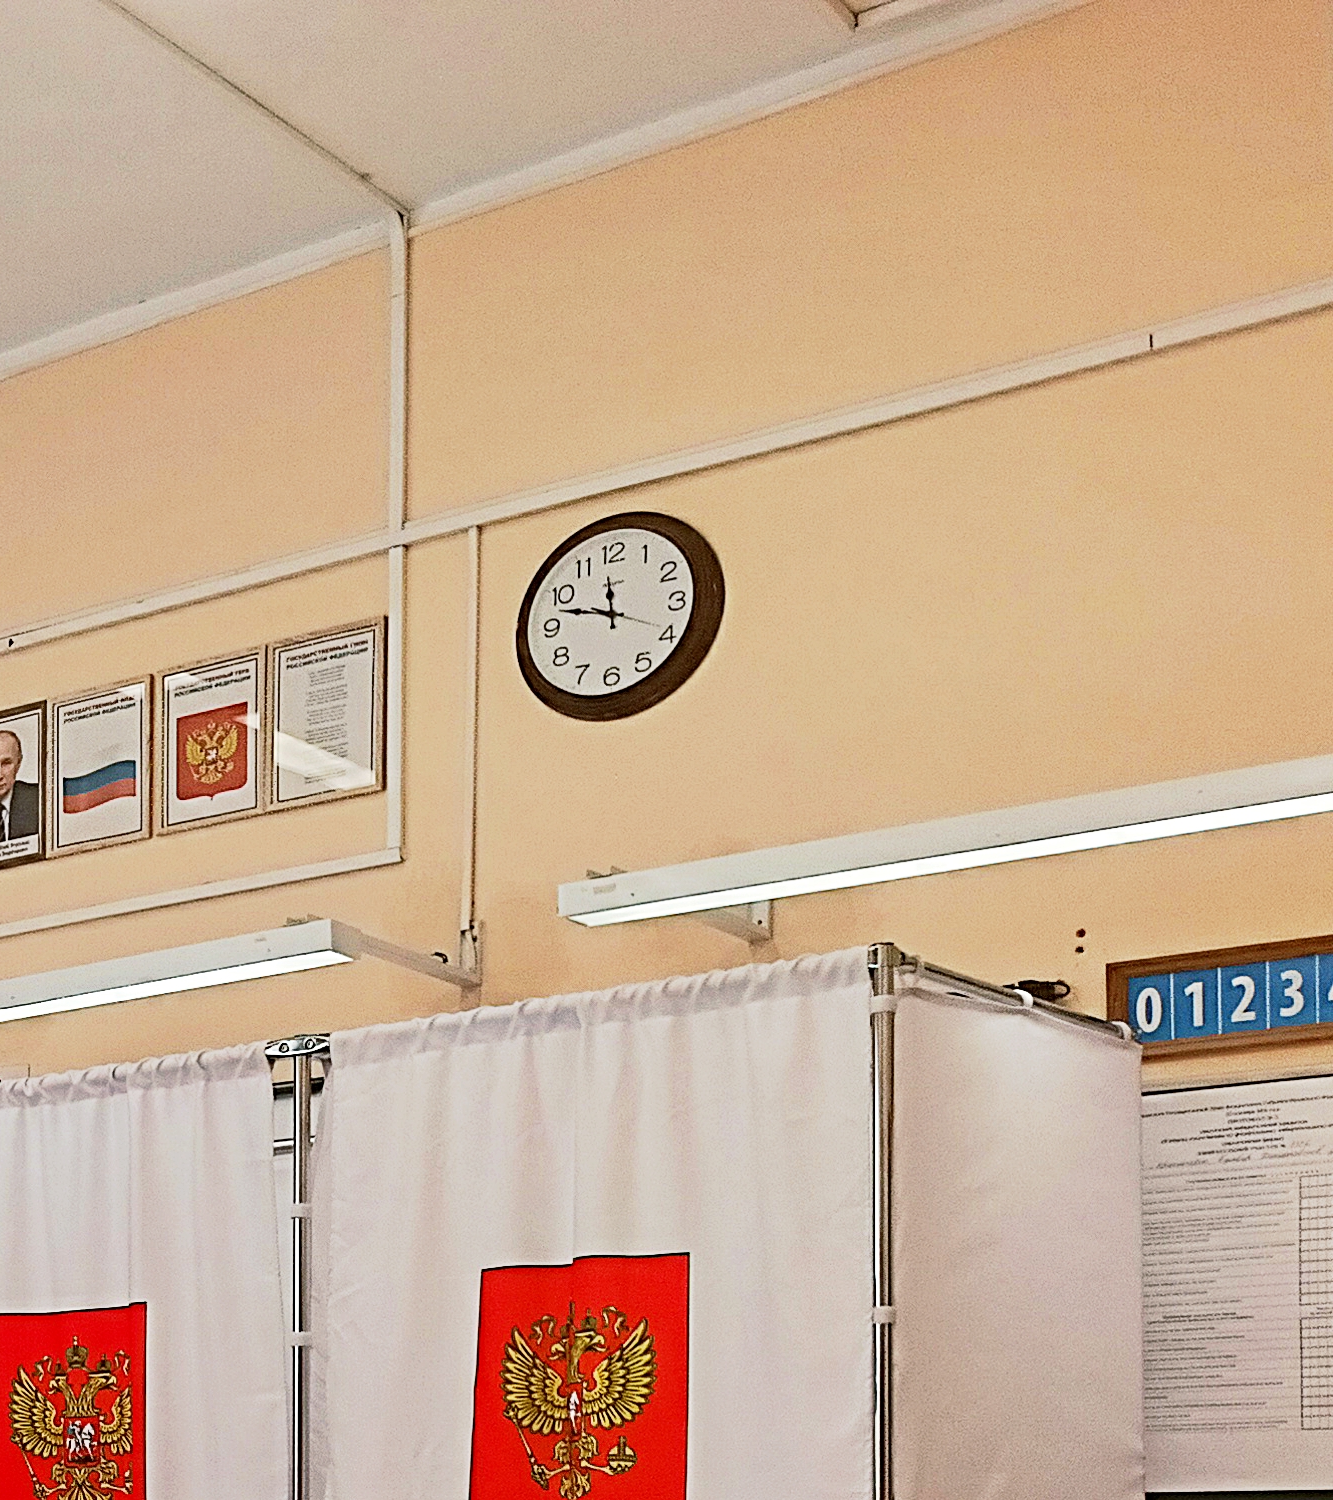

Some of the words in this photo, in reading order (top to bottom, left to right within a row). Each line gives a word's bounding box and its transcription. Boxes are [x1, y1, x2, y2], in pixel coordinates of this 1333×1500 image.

[601, 541, 625, 565] 12
[641, 544, 648, 564] 1
[575, 557, 591, 579] 11
[660, 561, 678, 583] 2
[552, 584, 575, 606] 10
[667, 590, 686, 611] 3
[543, 618, 560, 638] 9
[658, 624, 677, 644] 4
[552, 646, 570, 666] 8
[634, 651, 652, 672] 5
[574, 663, 590, 685] 7
[603, 666, 620, 686] 6
[1136, 987, 1162, 1033] 0
[1184, 981, 1204, 1027] 1
[1231, 975, 1256, 1023] 2
[1279, 969, 1304, 1017] 3
